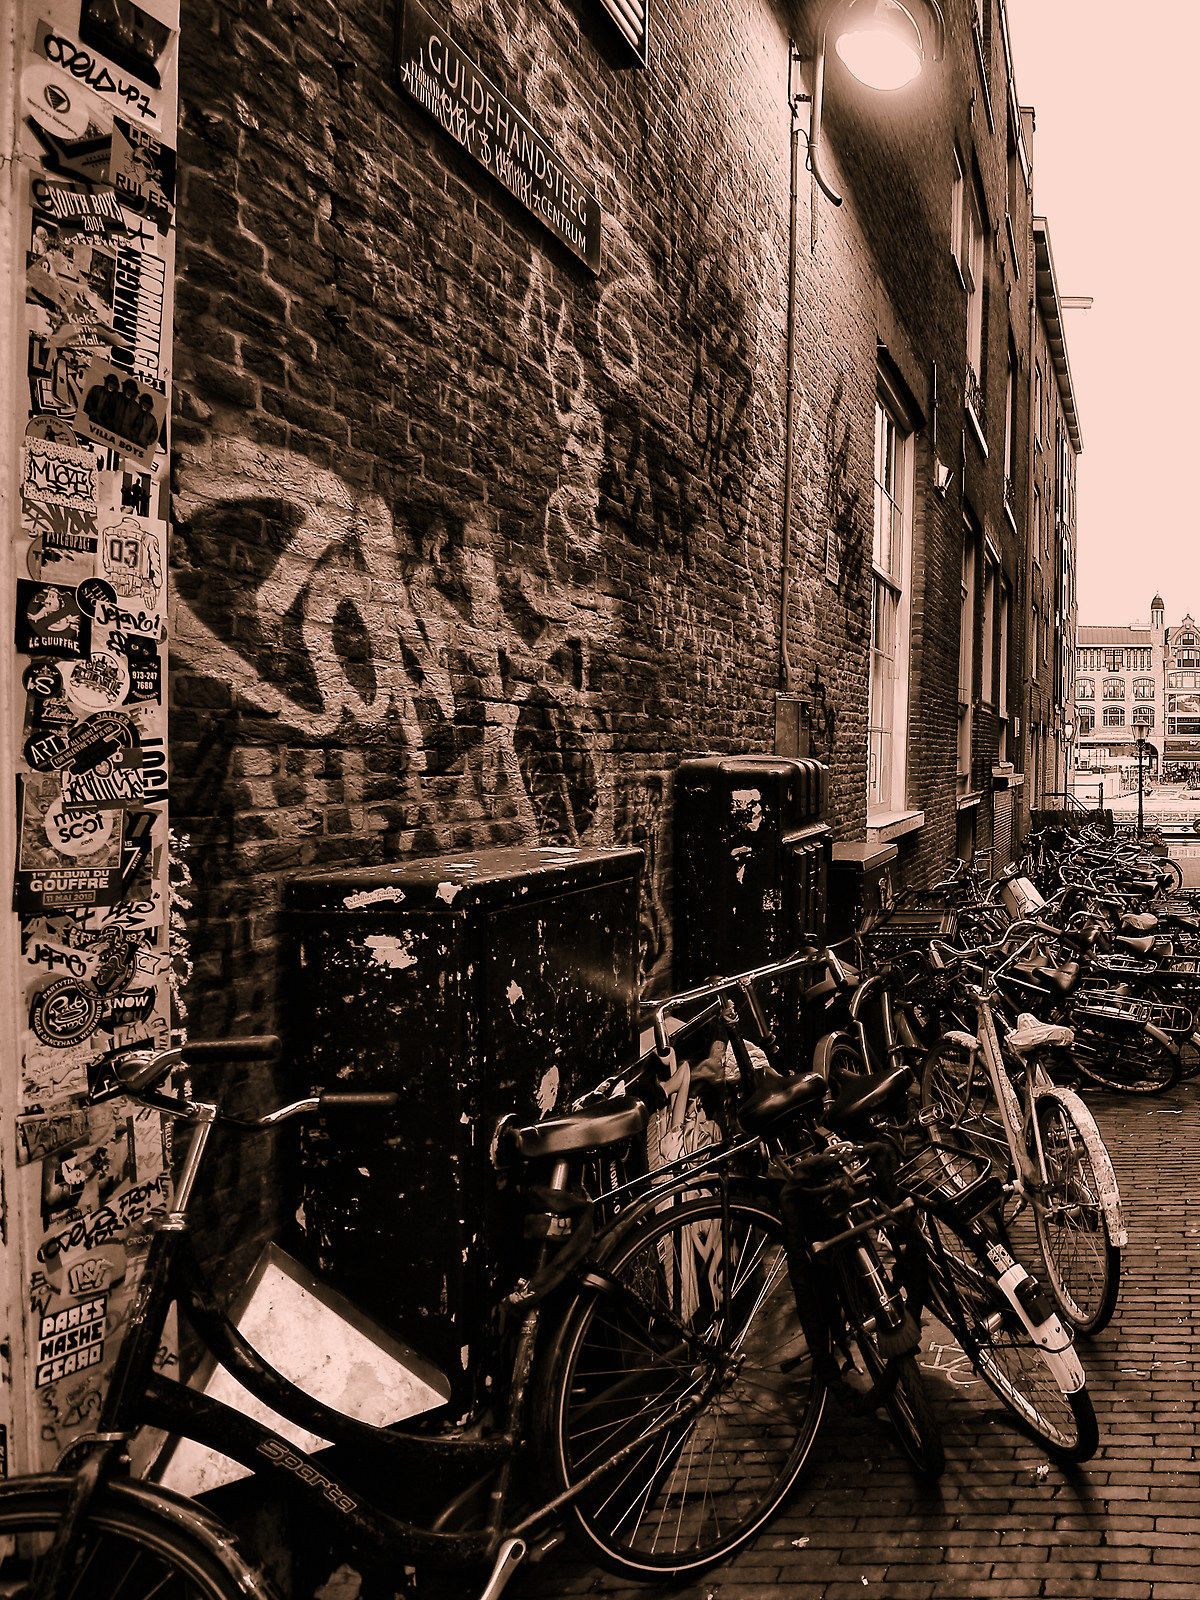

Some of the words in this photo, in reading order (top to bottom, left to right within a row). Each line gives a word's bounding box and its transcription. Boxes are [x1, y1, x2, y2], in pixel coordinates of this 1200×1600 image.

[428, 35, 587, 226] GULDEHANDSTEEG
[48, 186, 90, 219] SOUTH
[90, 191, 123, 223] BOYS
[82, 215, 105, 232] 2004
[541, 196, 586, 254] CENTRUM
[89, 424, 115, 444] VILLA
[119, 441, 144, 458] BOYS
[132, 671, 157, 680] 973-247
[49, 871, 90, 879] ALBUM
[30, 877, 109, 892] GOUFFRE
[55, 894, 72, 902] MAI
[74, 893, 93, 901] 2015
[114, 996, 149, 1009] NOW
[256, 1439, 357, 1514] Sparta
